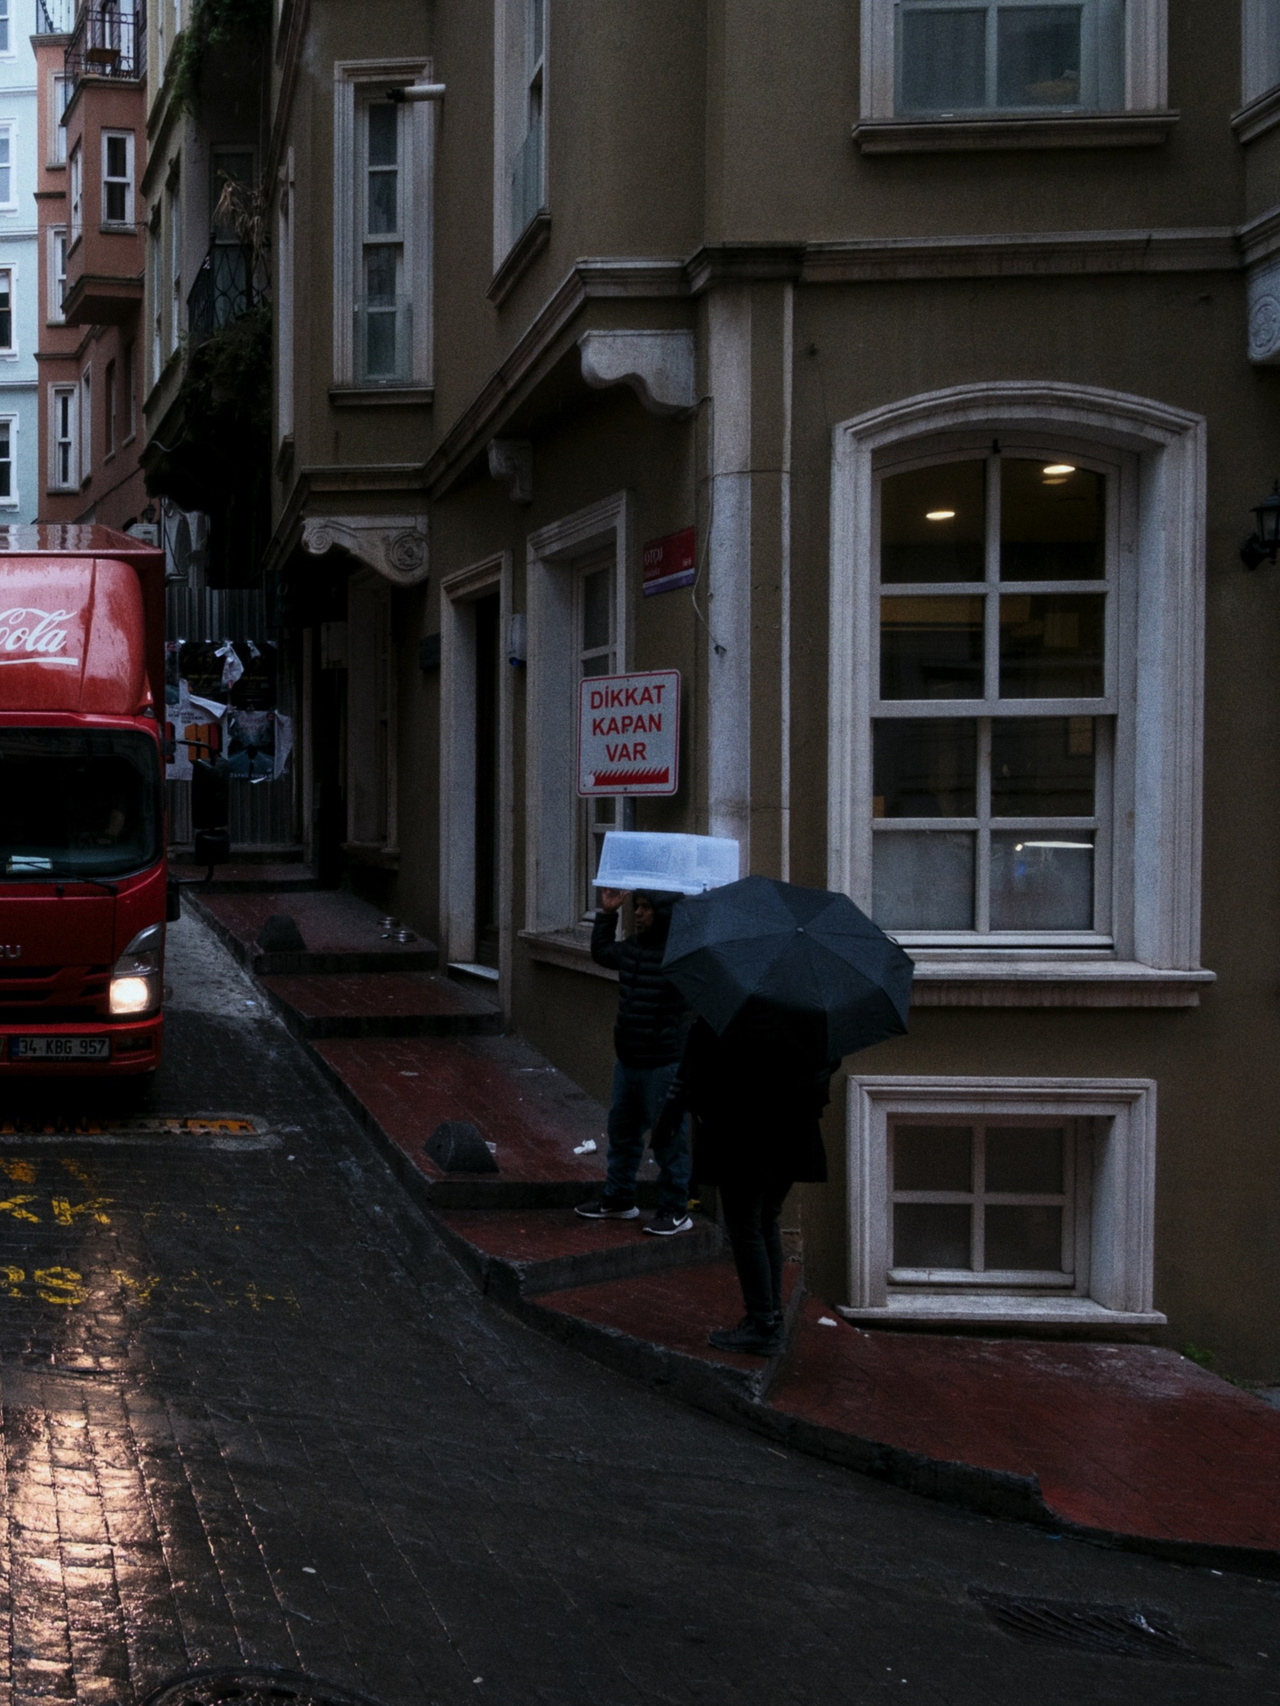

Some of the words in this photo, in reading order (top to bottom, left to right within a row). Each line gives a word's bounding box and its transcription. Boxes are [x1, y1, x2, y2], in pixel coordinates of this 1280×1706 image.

[591, 685, 665, 710] DİKKAT
[593, 713, 662, 736] KAPAN
[606, 742, 646, 762] VAR
[20, 1039, 37, 1055] 34
[46, 1039, 72, 1055] KBG
[80, 1039, 106, 1055] 957
